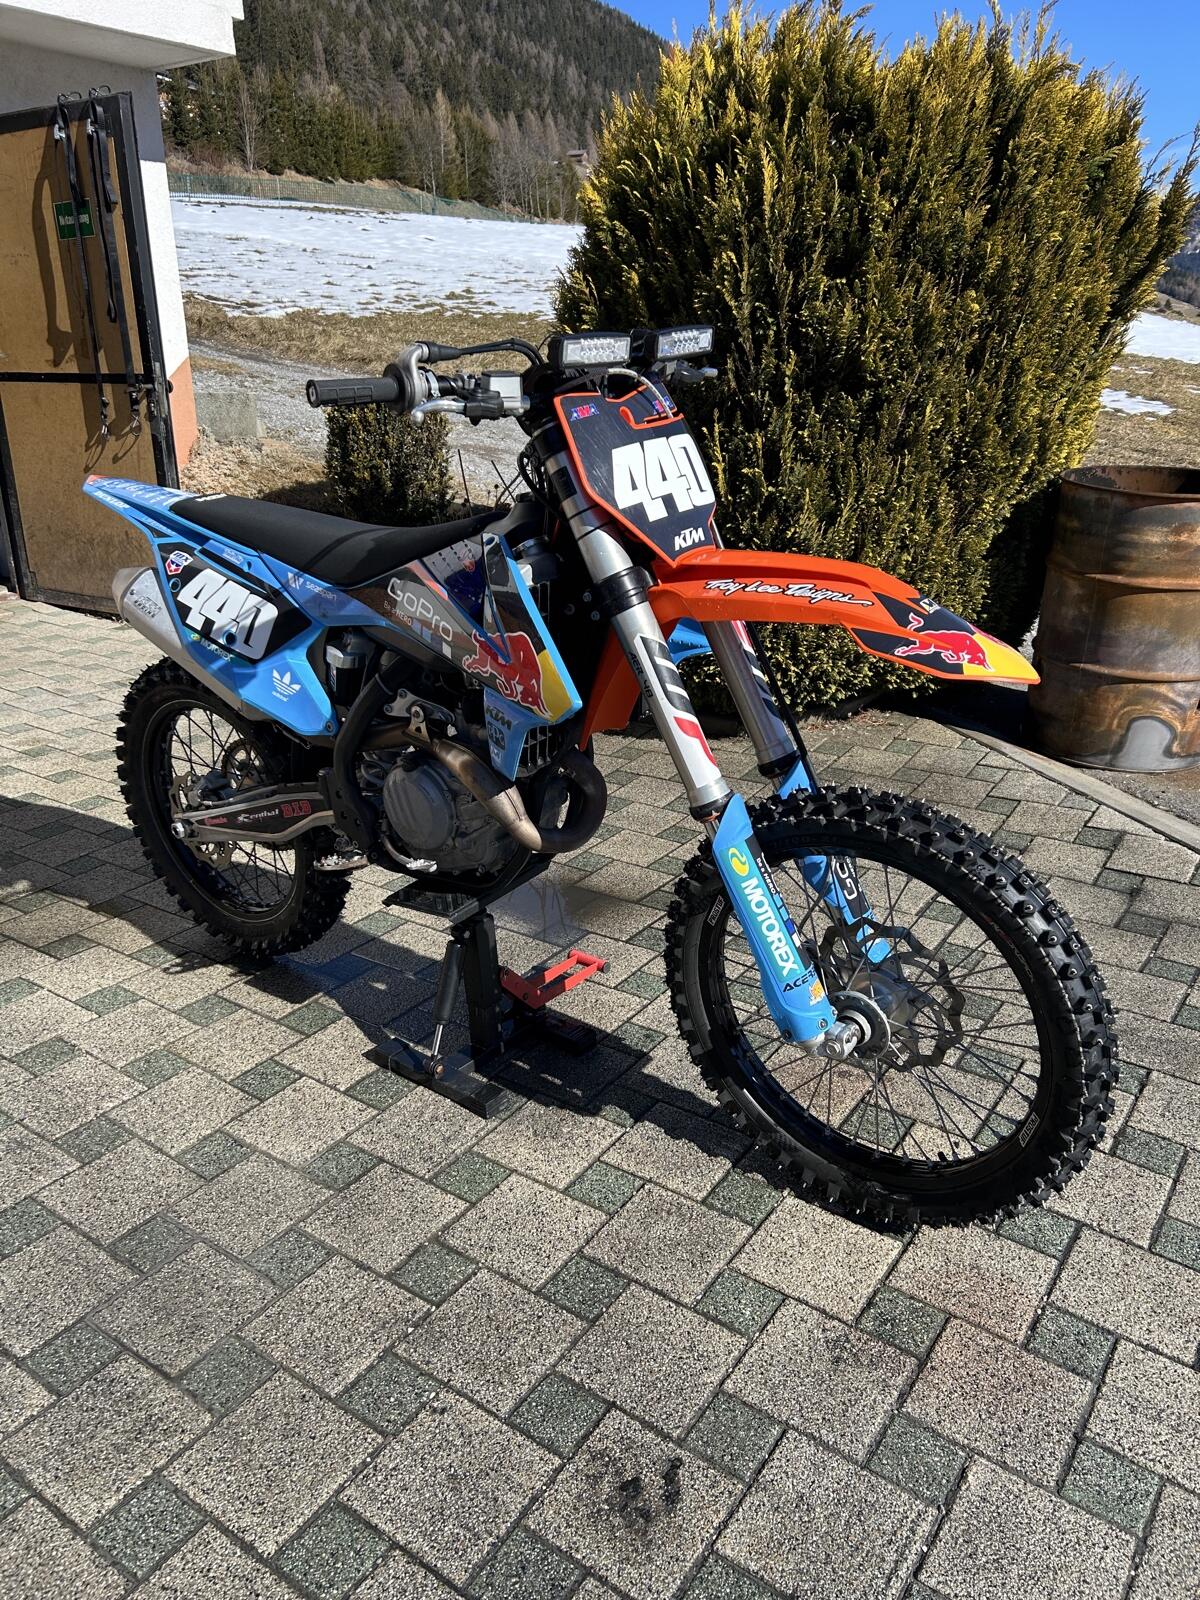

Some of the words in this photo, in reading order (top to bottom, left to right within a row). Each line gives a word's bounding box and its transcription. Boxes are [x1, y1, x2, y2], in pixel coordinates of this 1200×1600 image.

[569, 403, 600, 422] AMA
[611, 433, 715, 522] 440
[674, 527, 705, 551] KTM
[705, 578, 746, 596] Troy
[744, 580, 784, 593] Lee
[784, 583, 874, 606] Designs
[176, 568, 278, 660] 440
[387, 577, 453, 642] GoPro
[201, 638, 234, 661] MOTOREX
[486, 705, 513, 731] KTM
[741, 876, 798, 977] MOTOREX
